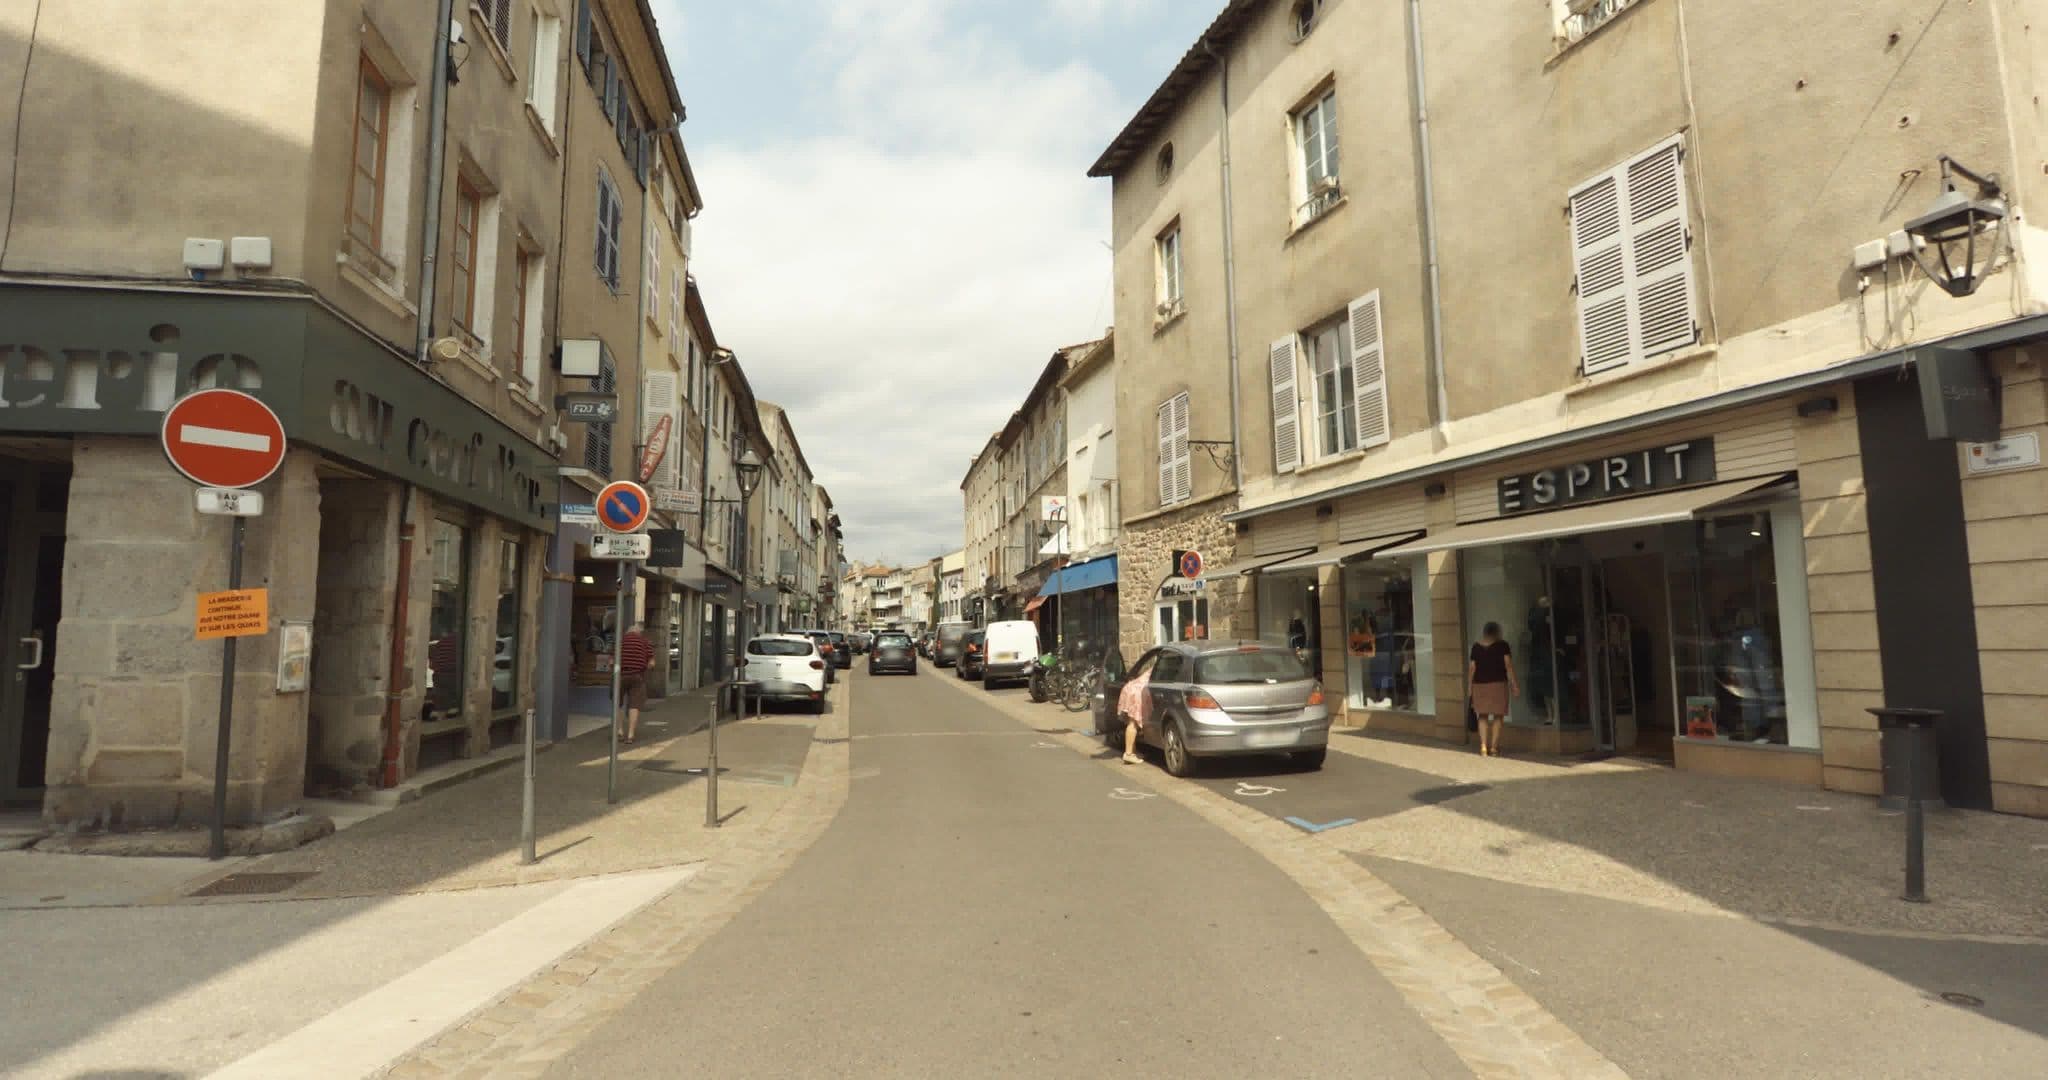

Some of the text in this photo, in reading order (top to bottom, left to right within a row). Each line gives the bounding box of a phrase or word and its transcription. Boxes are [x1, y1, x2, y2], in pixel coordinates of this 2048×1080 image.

[573, 404, 595, 413] FDJ
[1503, 443, 1690, 509] ESPRIT
[208, 597, 216, 605] LA
[199, 625, 207, 633] ET
